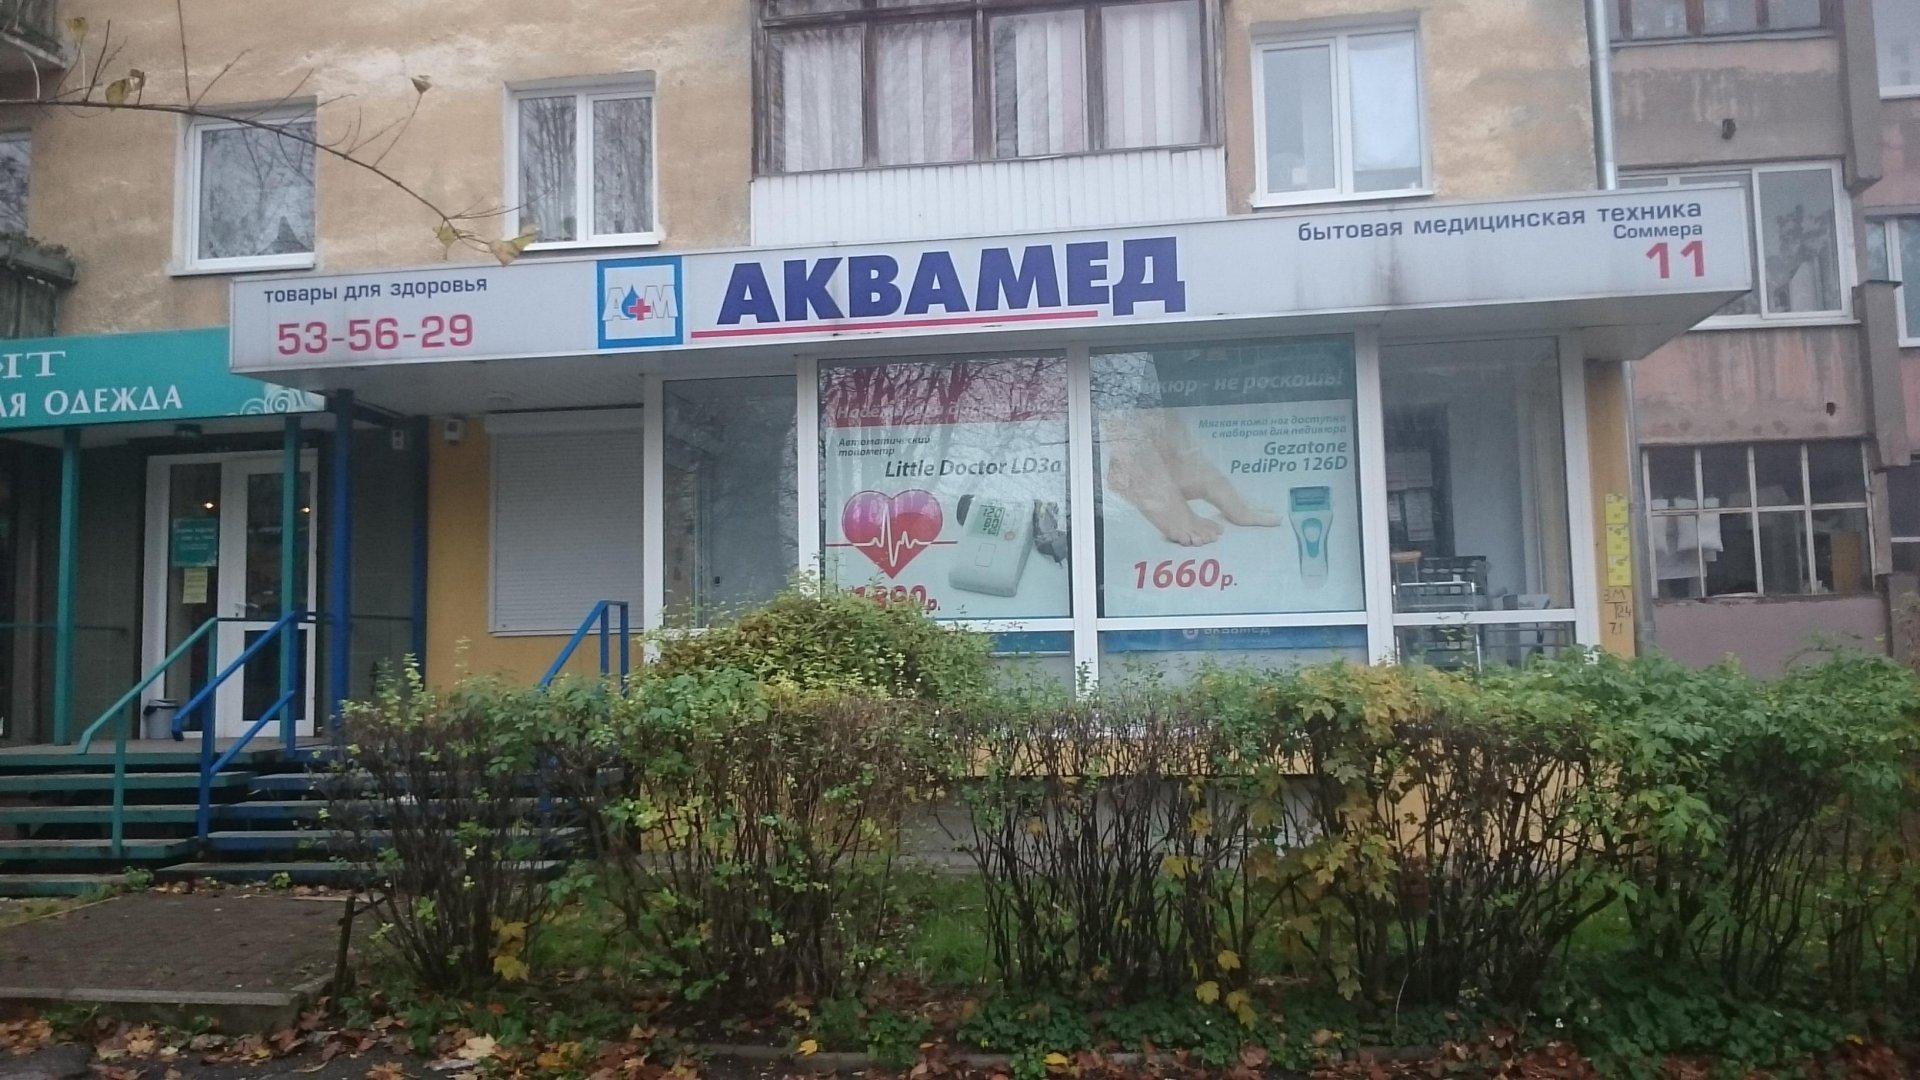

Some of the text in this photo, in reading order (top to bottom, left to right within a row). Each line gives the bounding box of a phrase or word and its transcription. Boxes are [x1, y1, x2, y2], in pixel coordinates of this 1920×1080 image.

[1298, 202, 1702, 241] бытовая медицинская техника
[1613, 222, 1702, 240] Соммера
[1645, 240, 1706, 279] 11
[264, 277, 488, 305] товары для здоровья
[716, 236, 1187, 325] АКВАМЕД
[277, 313, 474, 356] 53-56-29
[45, 384, 183, 416] ОДЕЖДА
[1263, 440, 1348, 456] Gezatone
[885, 457, 1063, 478] Little Doctor LD3a
[1230, 454, 1349, 475] PediPro 126D
